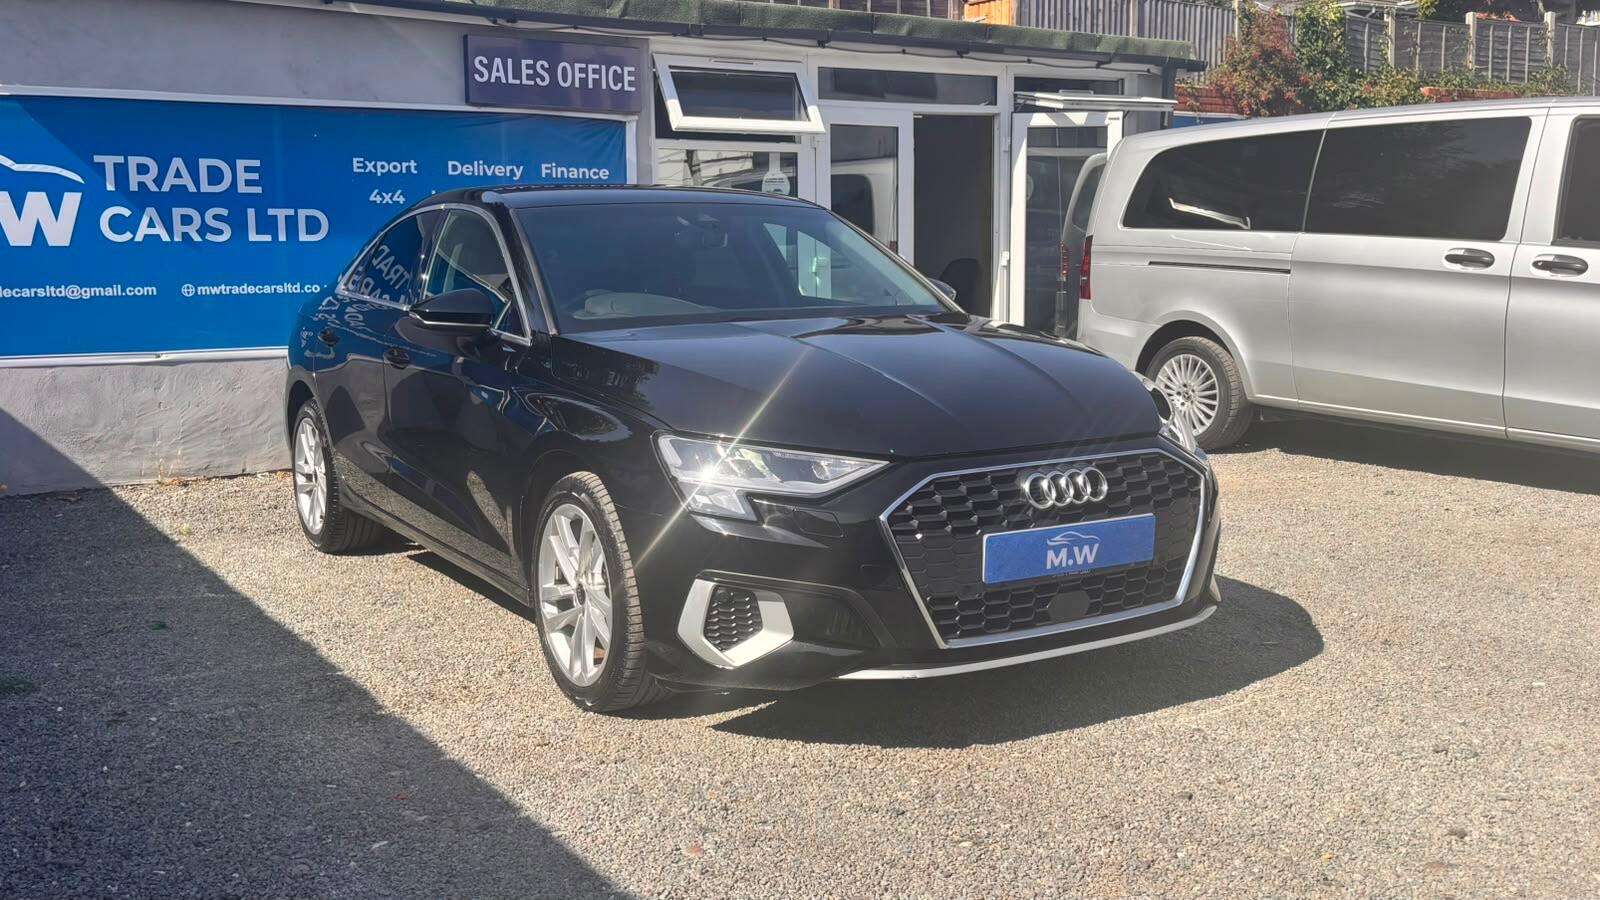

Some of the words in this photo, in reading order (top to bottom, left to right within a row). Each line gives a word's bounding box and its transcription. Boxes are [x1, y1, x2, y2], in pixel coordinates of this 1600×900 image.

[473, 55, 549, 87] SALES
[557, 61, 637, 92] OFFICE
[93, 154, 263, 194] TRADE
[352, 157, 418, 178] Export
[447, 159, 524, 181] Delivery
[541, 162, 610, 180] Finance
[369, 189, 406, 205] 4x4
[99, 205, 232, 243] CARS
[247, 207, 329, 242] LTD
[0, 284, 157, 300] ecarsltd@gmail.com
[197, 283, 327, 295] mwtradecarsltd.co
[1046, 543, 1100, 570] M.W
